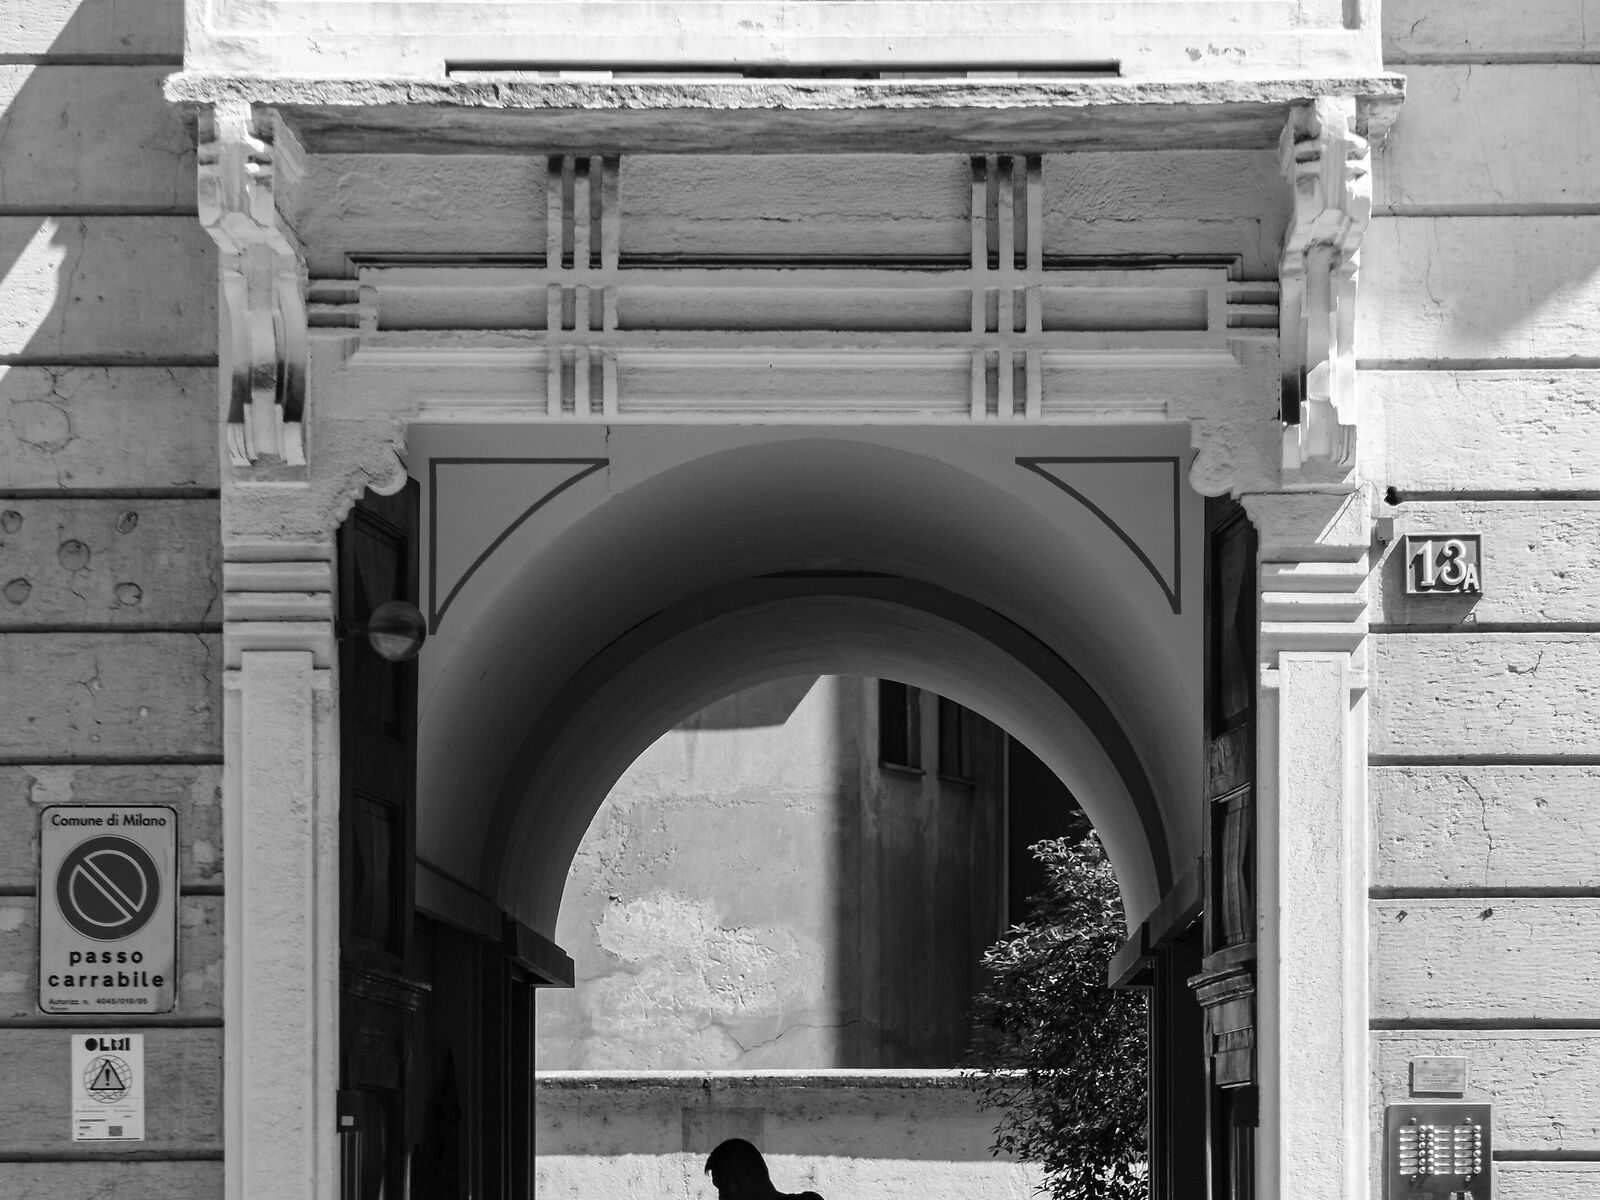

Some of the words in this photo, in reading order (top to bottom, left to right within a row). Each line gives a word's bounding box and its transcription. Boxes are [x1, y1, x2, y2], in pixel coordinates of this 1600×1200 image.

[51, 814, 103, 826] Comune
[107, 813, 119, 826] di
[123, 813, 167, 826] Milano
[70, 950, 143, 966] passo
[48, 971, 164, 987] carrabile
[85, 1037, 131, 1051] OLMI
